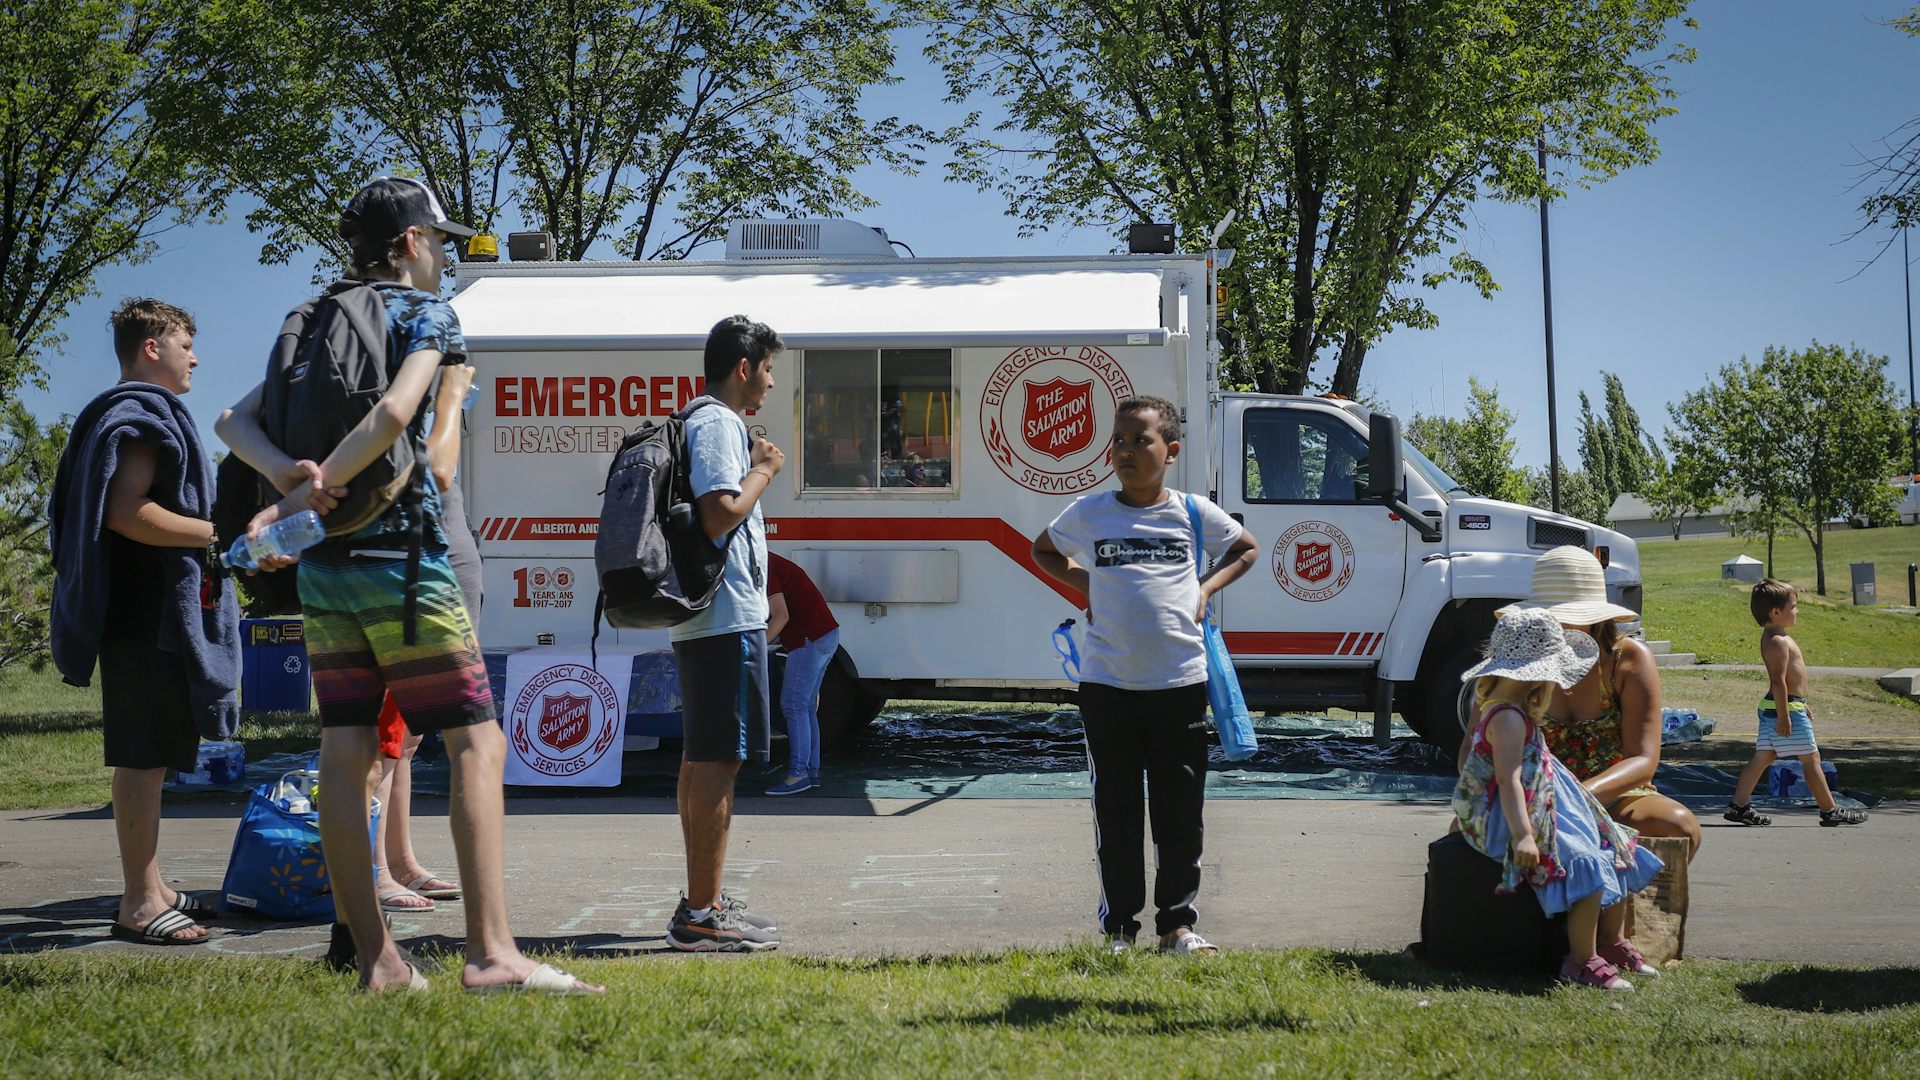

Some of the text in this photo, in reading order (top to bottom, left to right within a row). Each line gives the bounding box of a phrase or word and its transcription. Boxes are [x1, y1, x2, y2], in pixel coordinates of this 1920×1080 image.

[985, 346, 1068, 407] EMERGENCY
[495, 376, 757, 417] EMERGEN
[1035, 386, 1065, 413] THE
[1027, 391, 1087, 439] SALVATION
[494, 425, 626, 454] DISASTER
[1049, 414, 1087, 450] ARMY
[1020, 469, 1097, 491] SERVICES
[530, 523, 600, 534] ALBERTA AND
[1275, 522, 1353, 557] EMERGENCY DISASTER
[1098, 543, 1185, 561] Champion
[1296, 548, 1329, 573] SALVATION
[1301, 545, 1317, 559] THE
[1308, 561, 1329, 578] ARMY
[532, 591, 574, 600] YEARS ANS
[1292, 588, 1334, 600] SERVICES
[516, 667, 616, 714] EMERGENCY DISASTER
[541, 702, 588, 738] SALVATION
[549, 698, 571, 718] THE
[556, 718, 584, 745] ARMY
[533, 757, 586, 773] SERVICES
